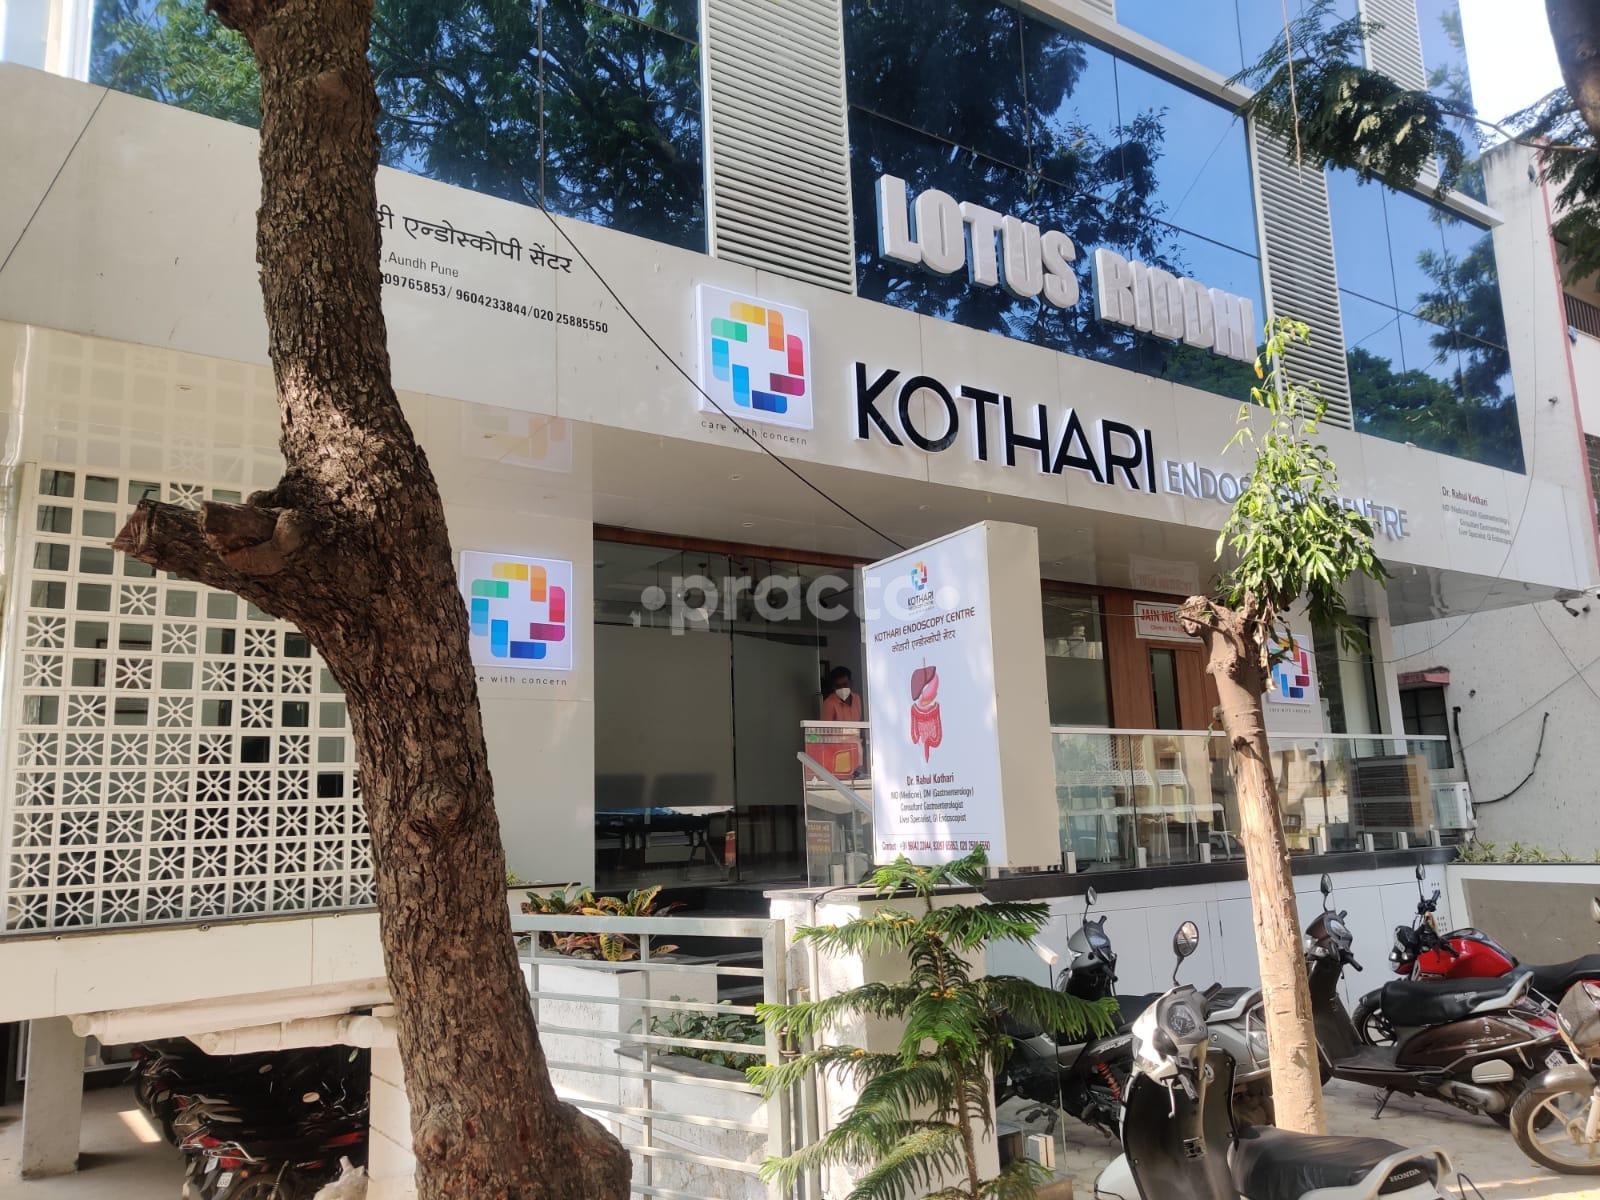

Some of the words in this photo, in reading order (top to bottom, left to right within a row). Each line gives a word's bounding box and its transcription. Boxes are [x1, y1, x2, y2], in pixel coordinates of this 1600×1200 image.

[430, 260, 459, 278] Pune
[529, 242, 573, 274] सेंटर
[875, 174, 1080, 309] LOTUS
[1091, 247, 1256, 364] RIDDHI
[556, 312, 608, 334] 25885550
[701, 420, 727, 432] care
[762, 431, 807, 446] concern
[850, 361, 1157, 494] KOTHARI
[874, 626, 902, 643] KOTHARI
[902, 615, 945, 635] ENDOSCOPY
[945, 606, 976, 623] CENTRE
[491, 675, 516, 684] with
[521, 676, 567, 686] concern
[932, 771, 955, 784] Kothari
[1389, 1168, 1421, 1182] HONDA
